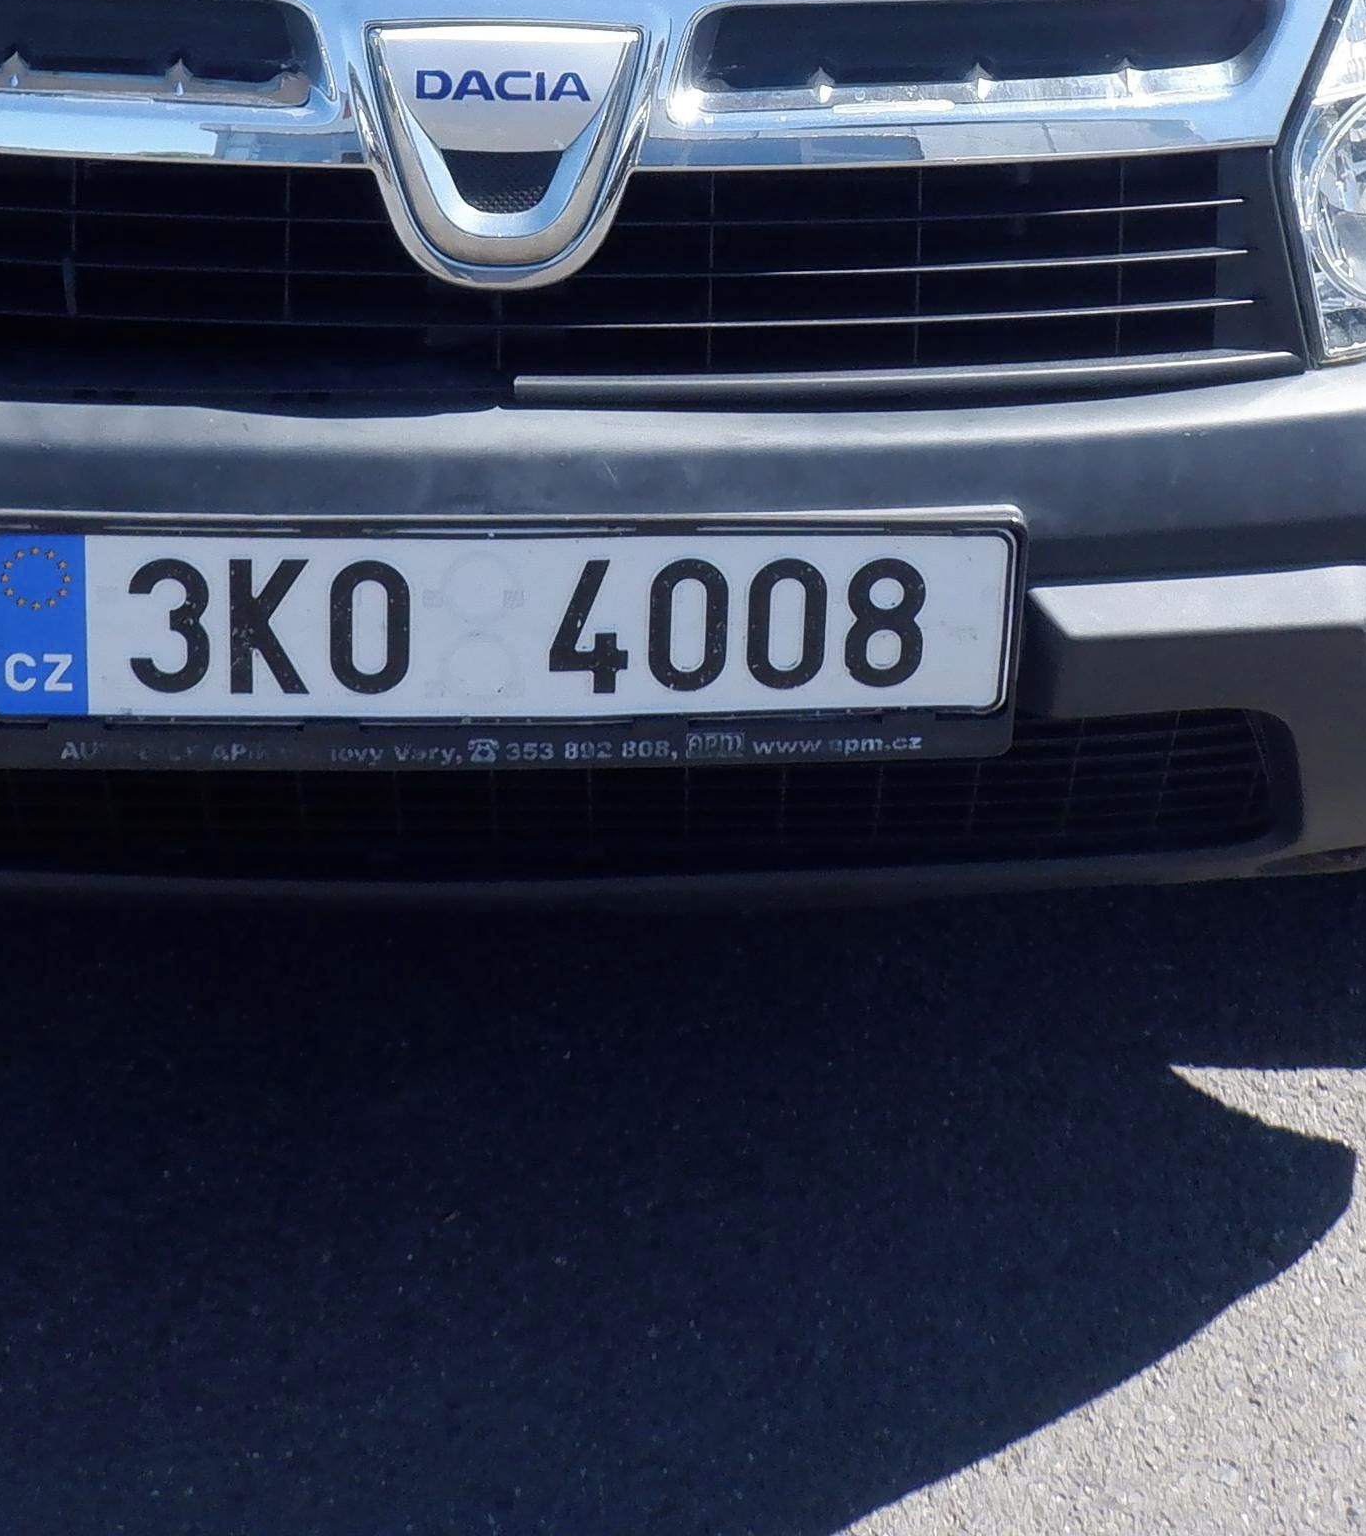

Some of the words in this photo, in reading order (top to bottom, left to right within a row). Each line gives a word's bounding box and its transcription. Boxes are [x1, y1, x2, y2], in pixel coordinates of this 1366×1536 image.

[415, 69, 591, 102] DACIA
[128, 557, 410, 695] 3K0
[549, 557, 927, 695] 4008
[4, 652, 73, 693] CZ
[505, 741, 554, 760] 353
